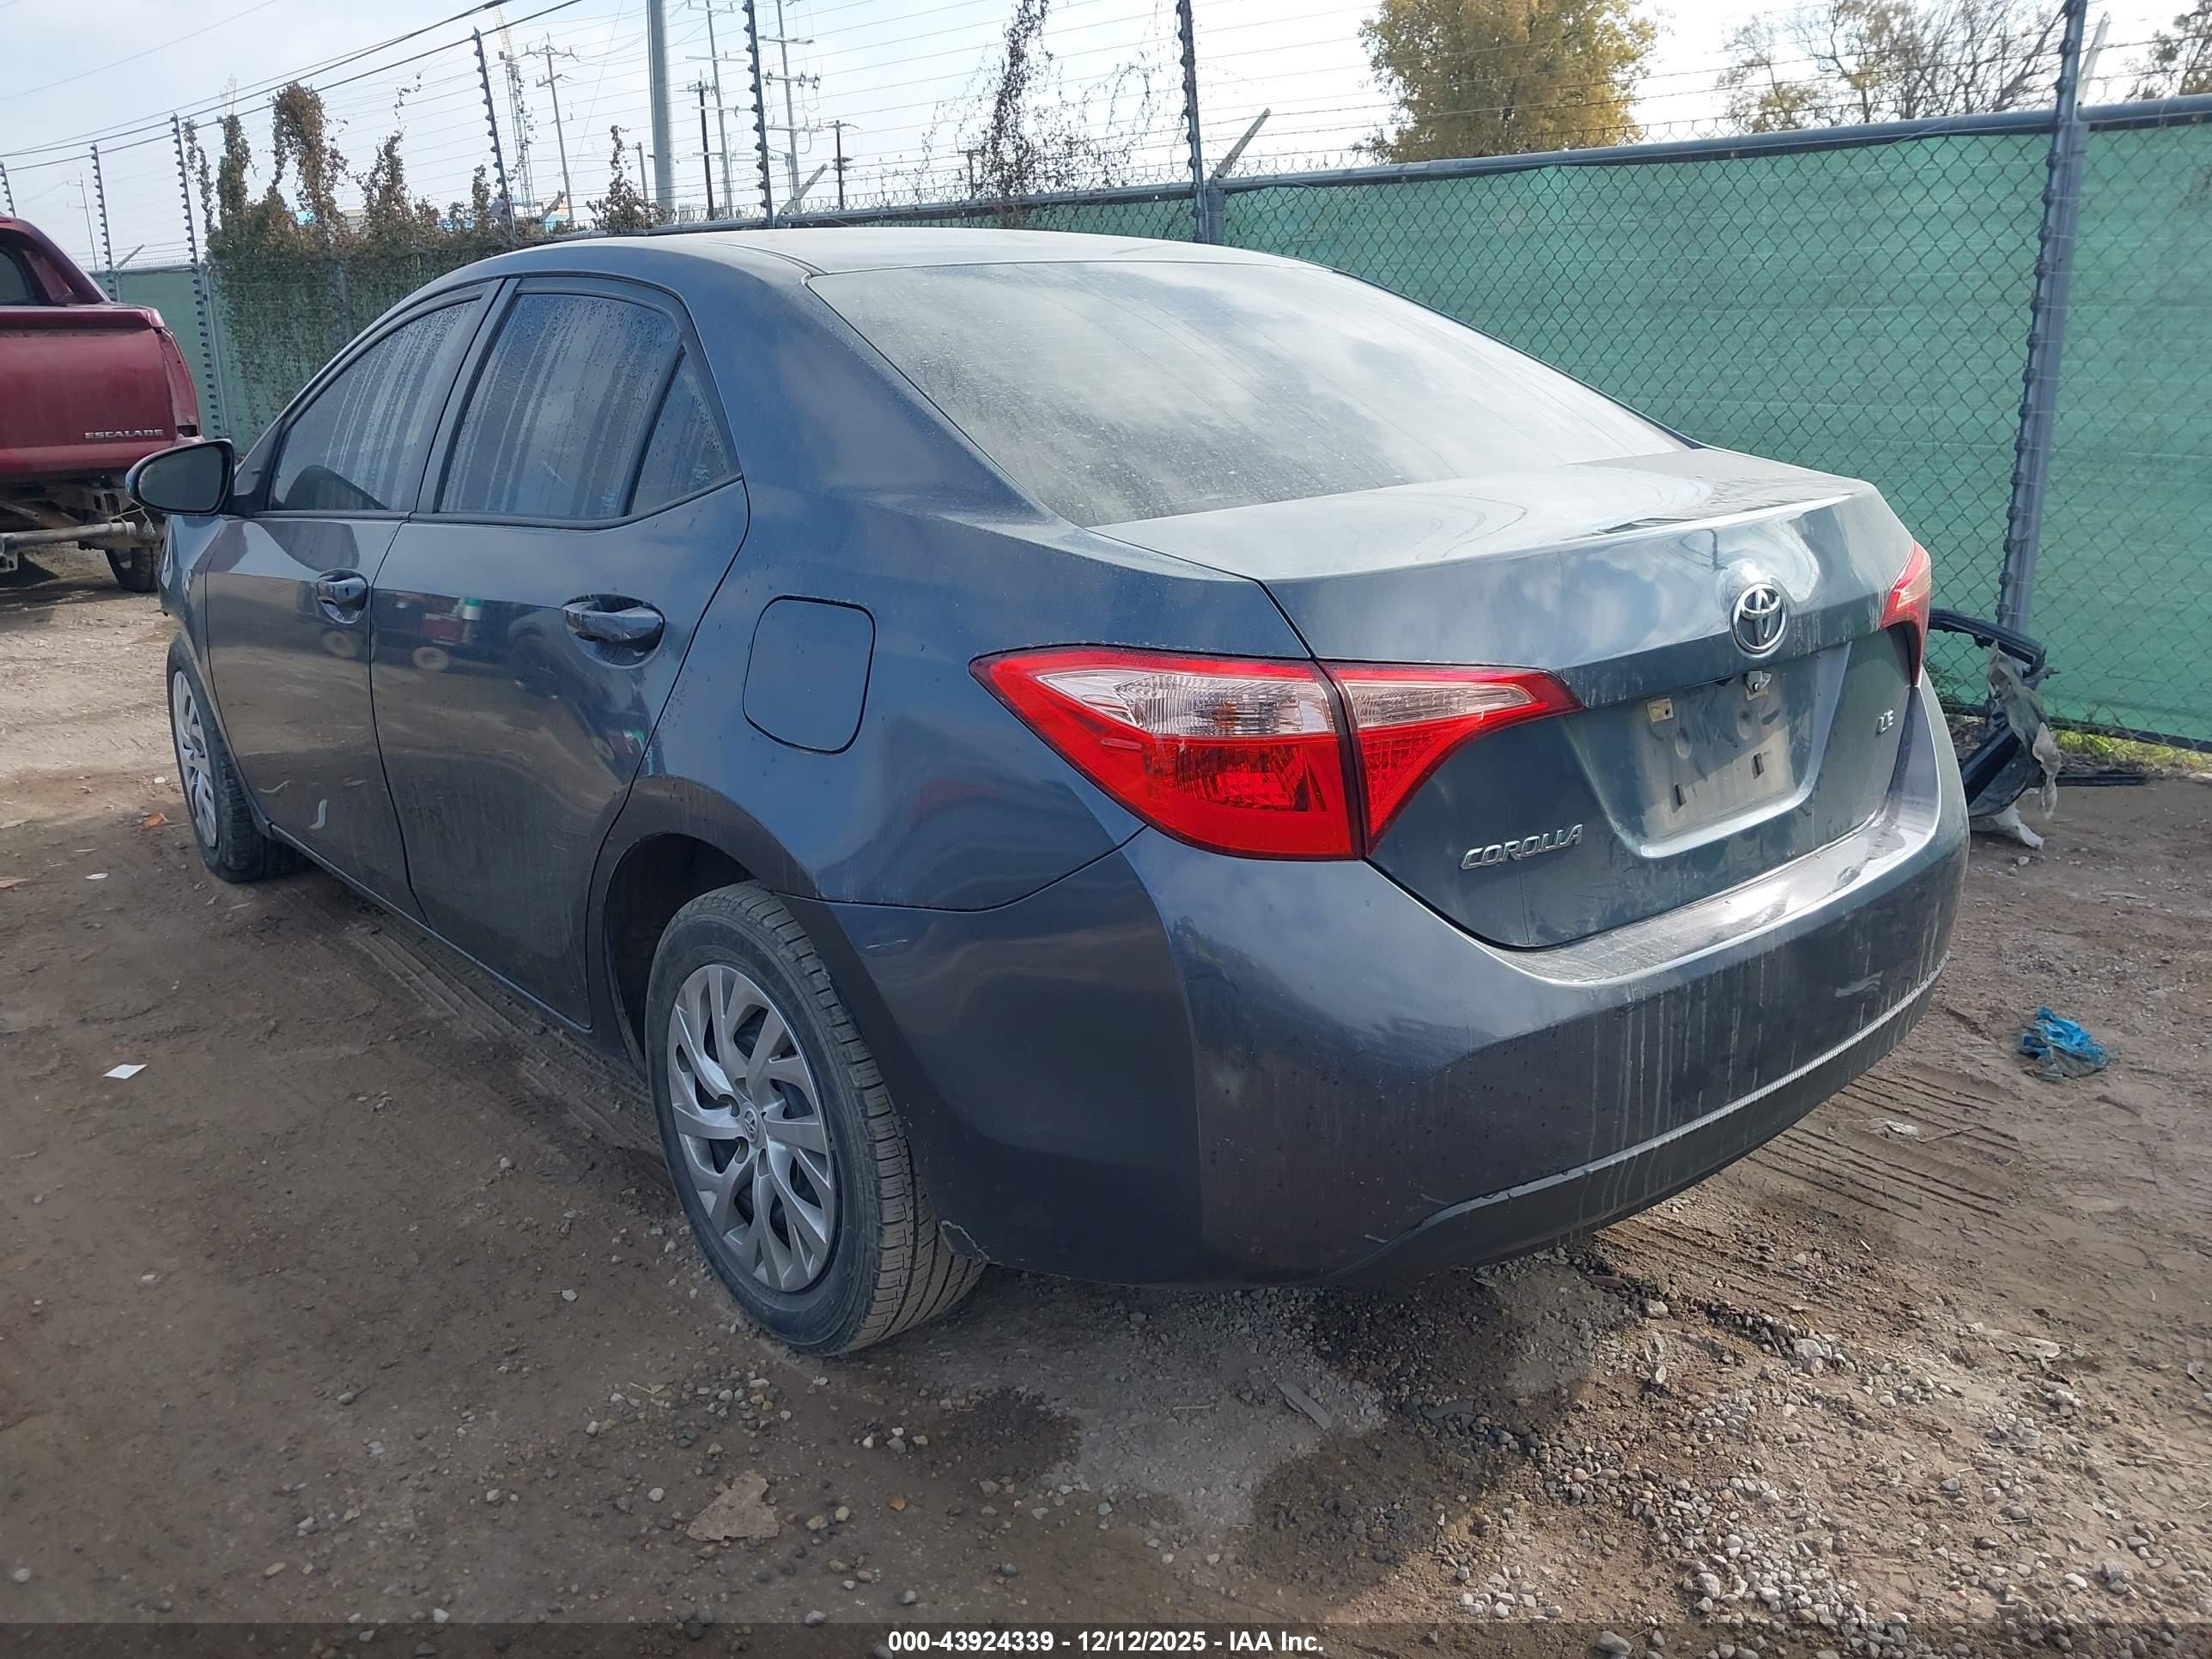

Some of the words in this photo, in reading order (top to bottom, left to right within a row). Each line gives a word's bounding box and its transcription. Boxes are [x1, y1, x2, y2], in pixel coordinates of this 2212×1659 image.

[84, 428, 164, 440] ESCALADE
[1875, 708, 1895, 736] LE
[1460, 823, 1583, 870] COROLLA
